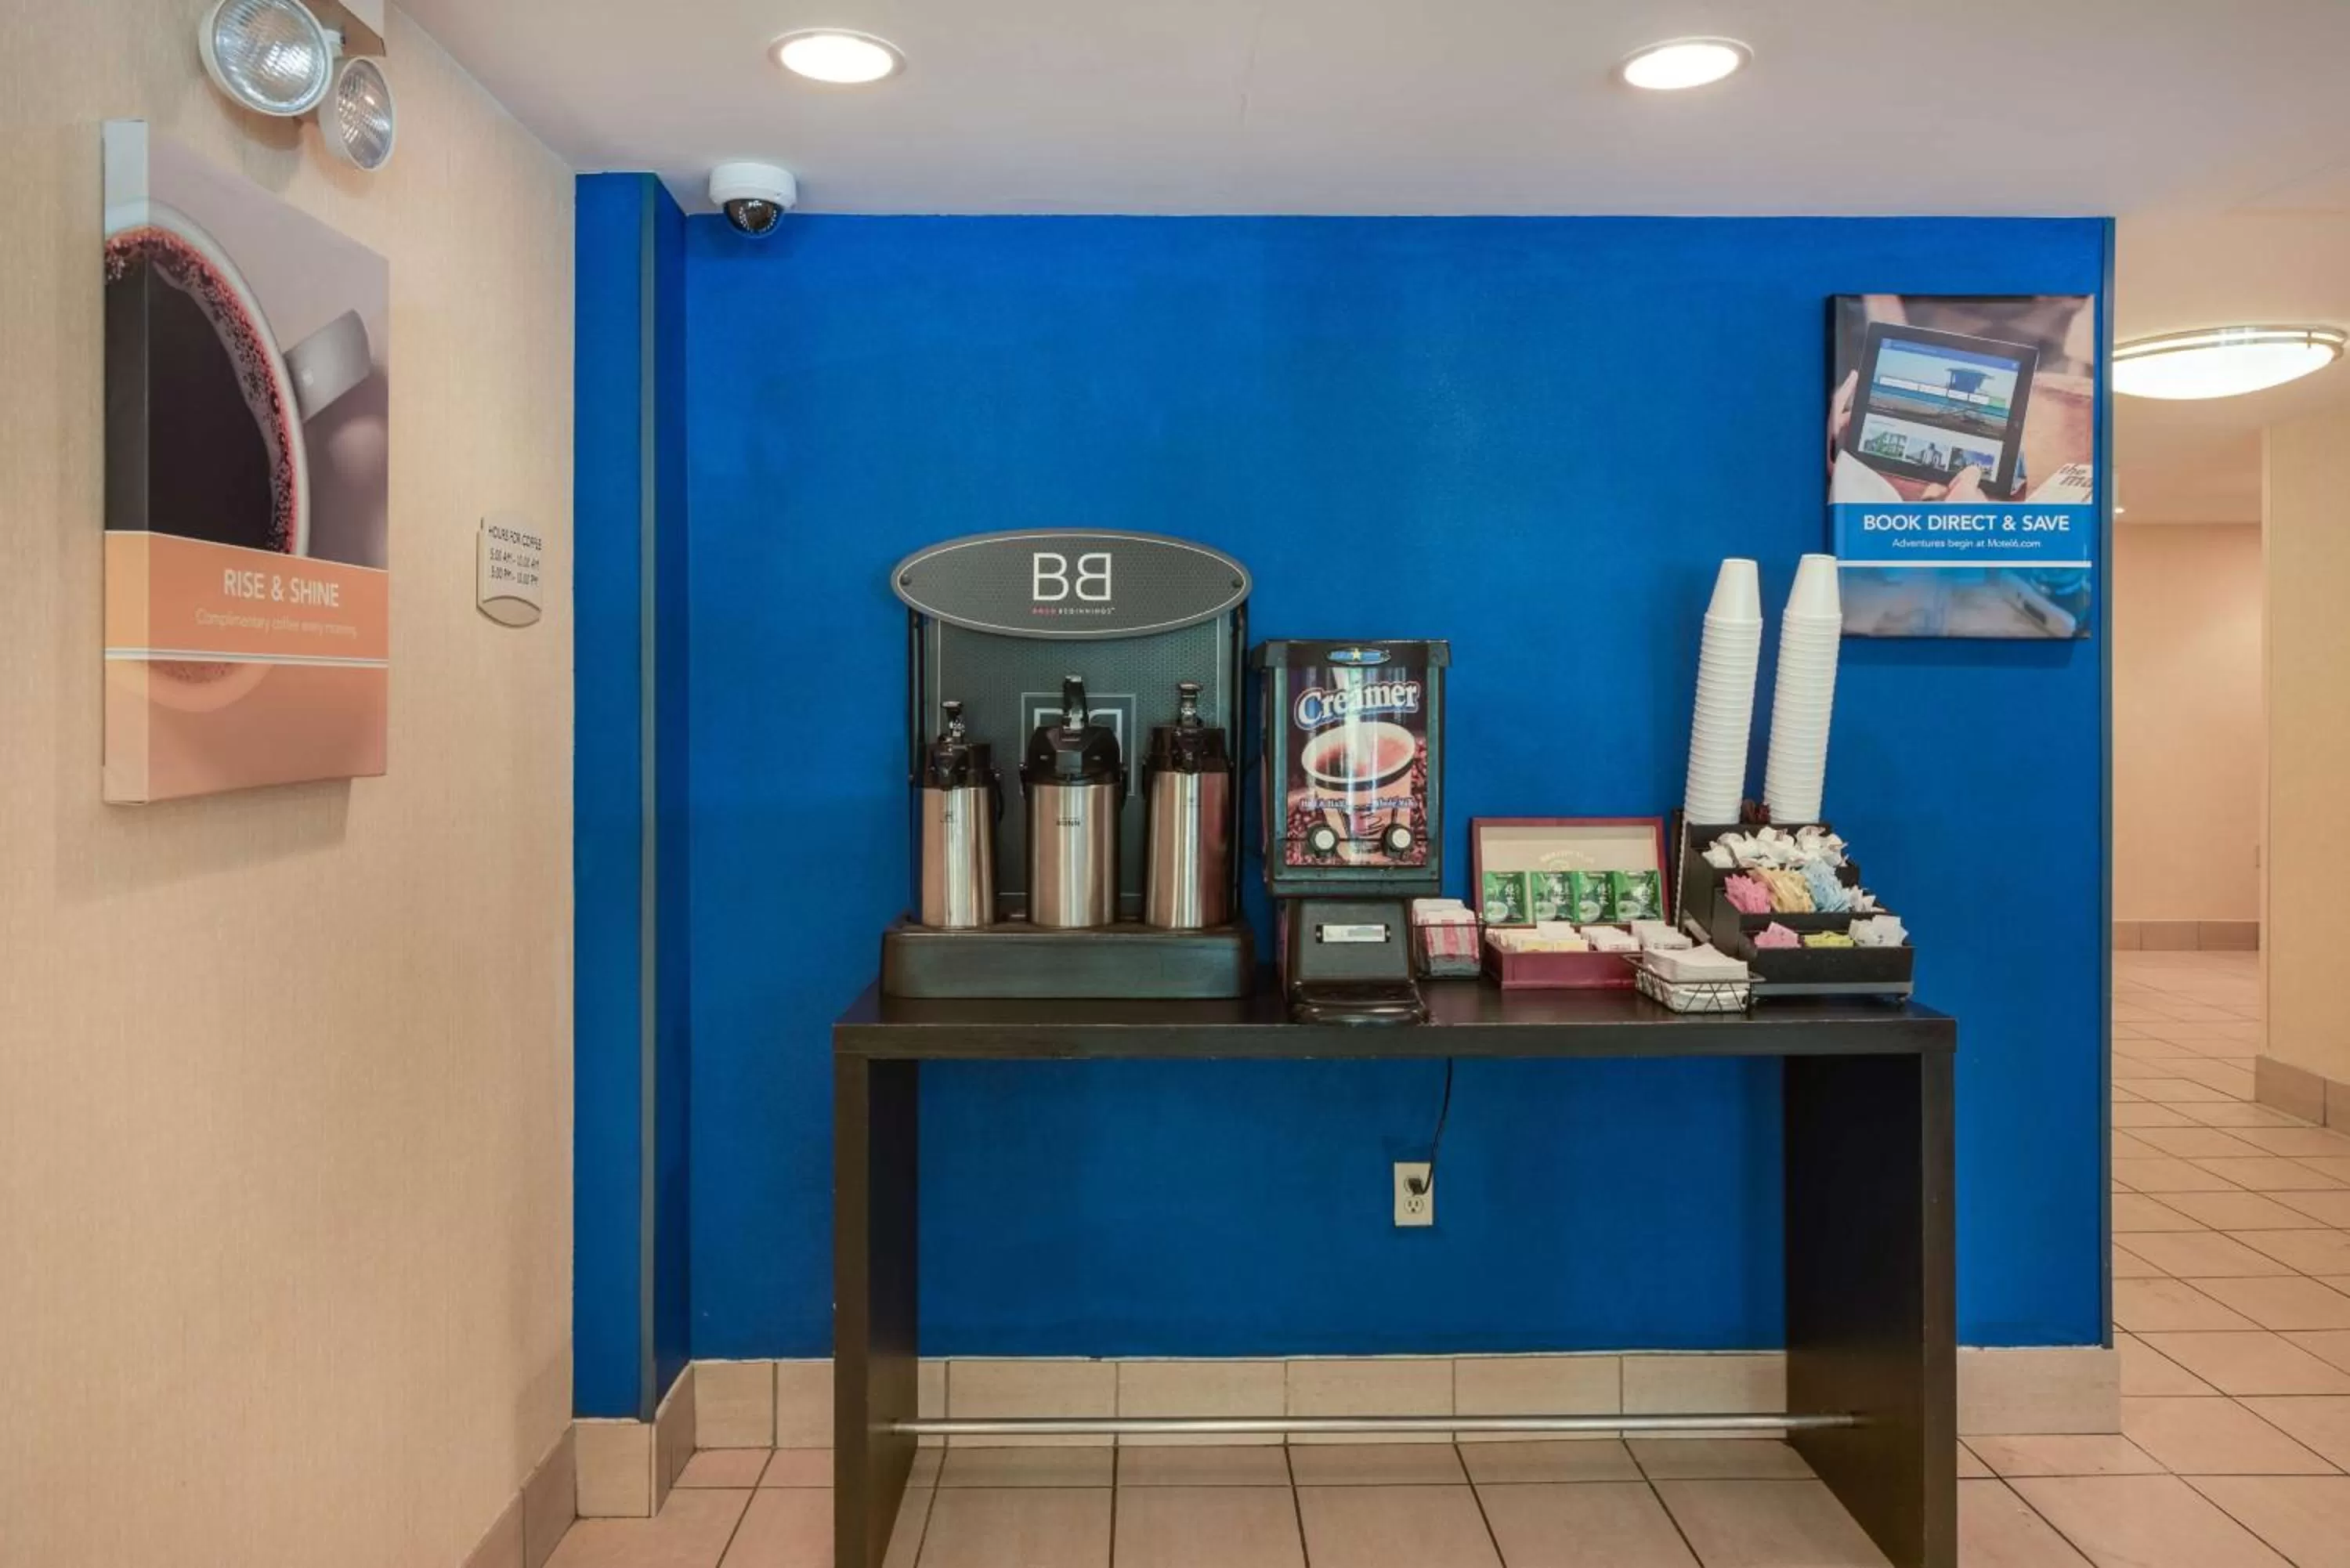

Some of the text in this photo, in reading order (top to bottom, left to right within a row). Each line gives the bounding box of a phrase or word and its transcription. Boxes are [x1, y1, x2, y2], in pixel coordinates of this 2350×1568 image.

[1863, 515, 2070, 531] BOOK DIRECT & SAVE
[1892, 538, 2041, 550] Adventures begin at Motel6.com
[224, 568, 339, 607] RISE & SHINE
[1296, 682, 1419, 727] Creamer
